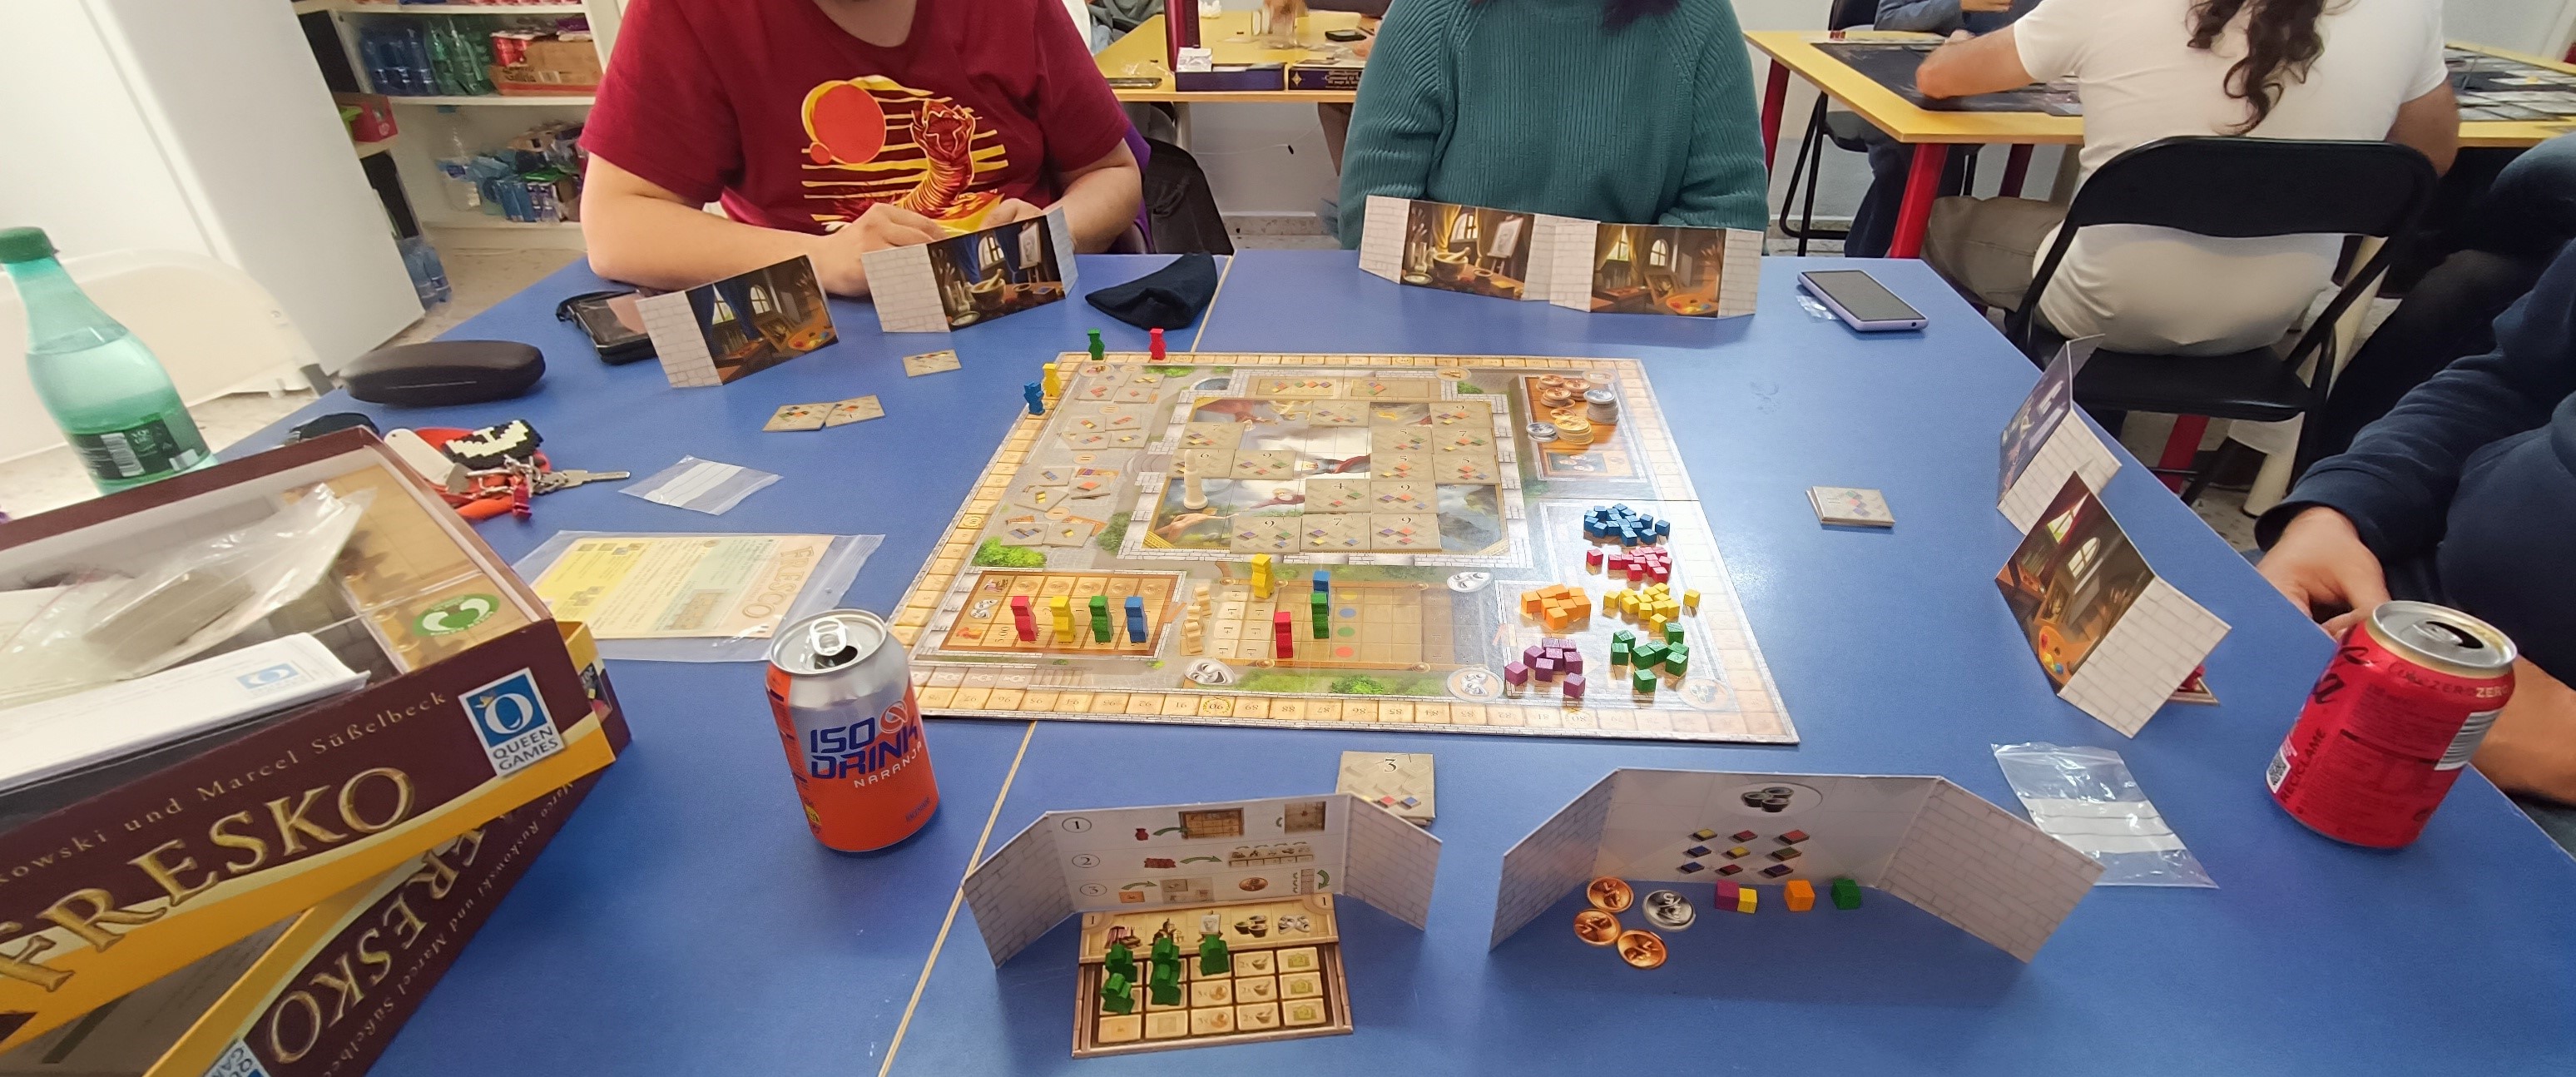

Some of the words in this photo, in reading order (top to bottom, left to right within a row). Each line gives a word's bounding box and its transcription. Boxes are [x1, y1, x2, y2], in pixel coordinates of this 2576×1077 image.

[742, 546, 815, 618] FRESCO
[493, 726, 553, 760] QUEEN
[499, 737, 558, 770] GAMES
[810, 717, 875, 754] ISO
[811, 715, 919, 779] DRINK
[124, 797, 184, 831] und
[196, 750, 299, 802] Marcel
[310, 692, 447, 756] Süßelbeck
[854, 740, 923, 788] NARANJA
[1383, 758, 1397, 772] 3
[477, 821, 539, 896] Ruskowski
[1081, 856, 1092, 866] 2
[1087, 885, 1099, 896] 3
[1662, 892, 1675, 904] 5
[448, 896, 476, 933] und
[396, 932, 448, 995] Marcel
